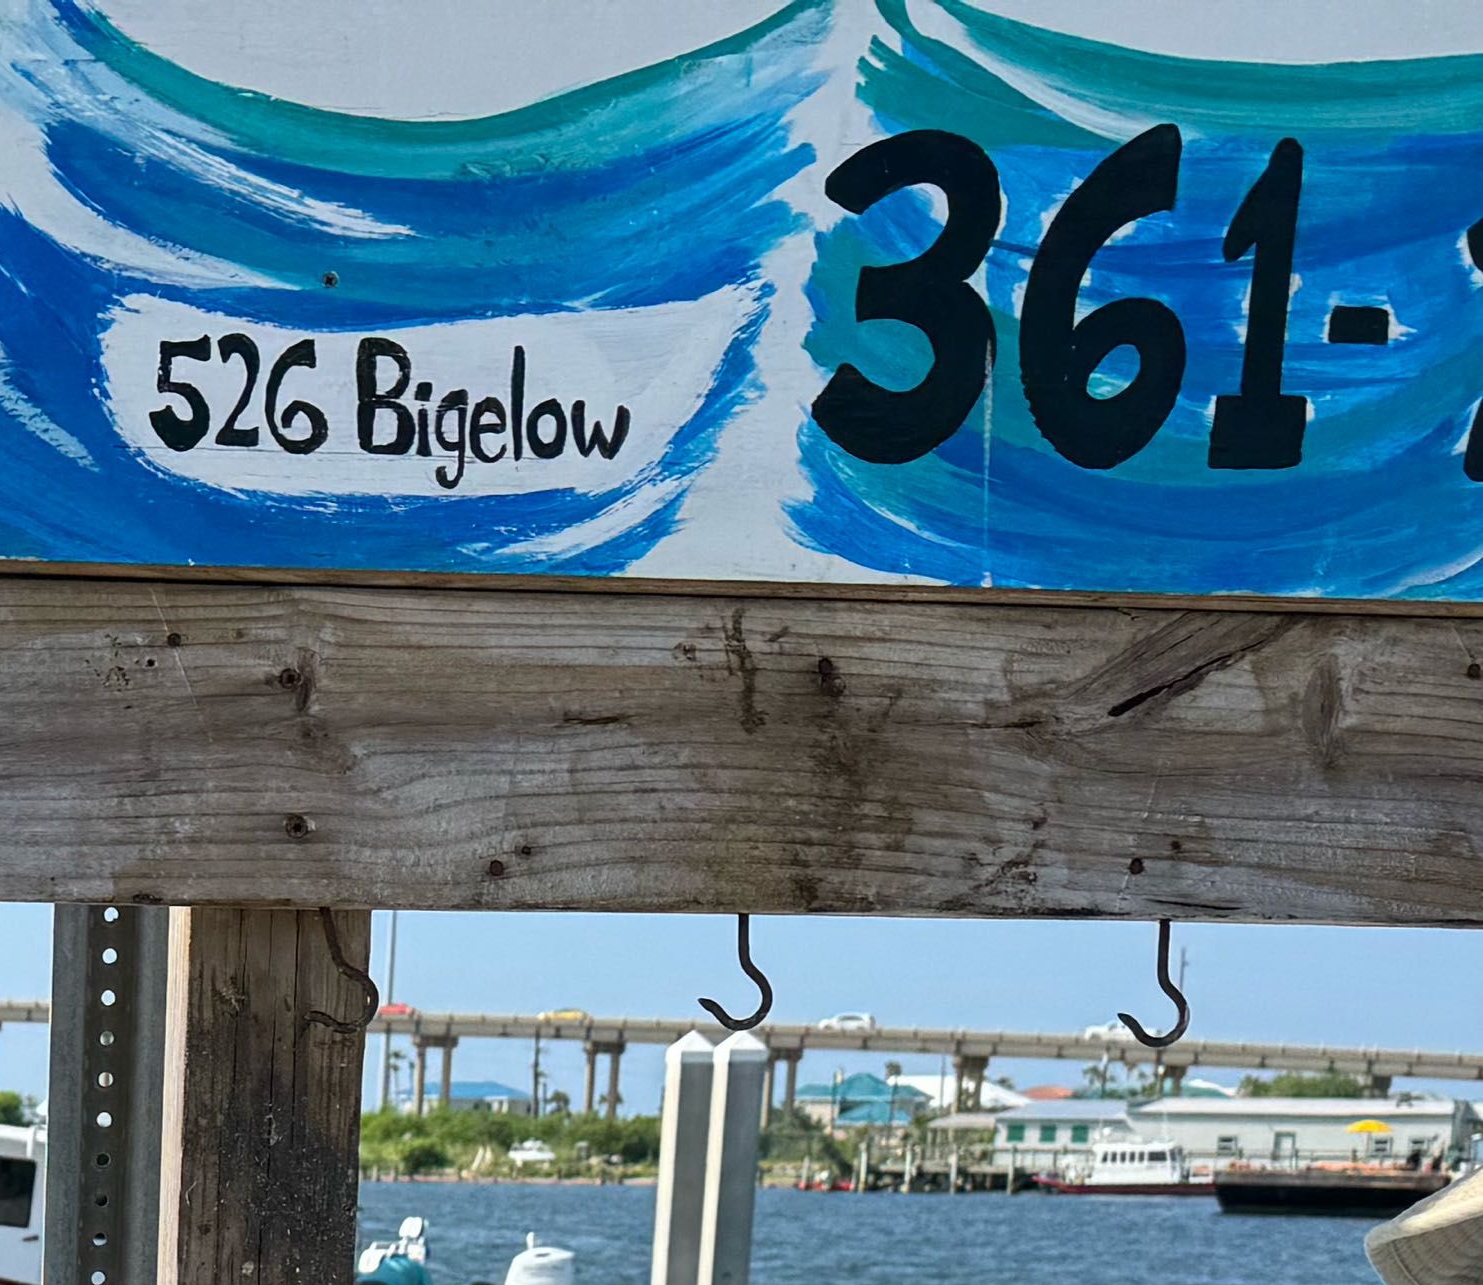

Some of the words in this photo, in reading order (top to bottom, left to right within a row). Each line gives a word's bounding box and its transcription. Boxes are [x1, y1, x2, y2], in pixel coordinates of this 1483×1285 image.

[149, 333, 328, 454] 526
[356, 337, 631, 489] Bigelow
[811, 123, 1483, 482] 361-
